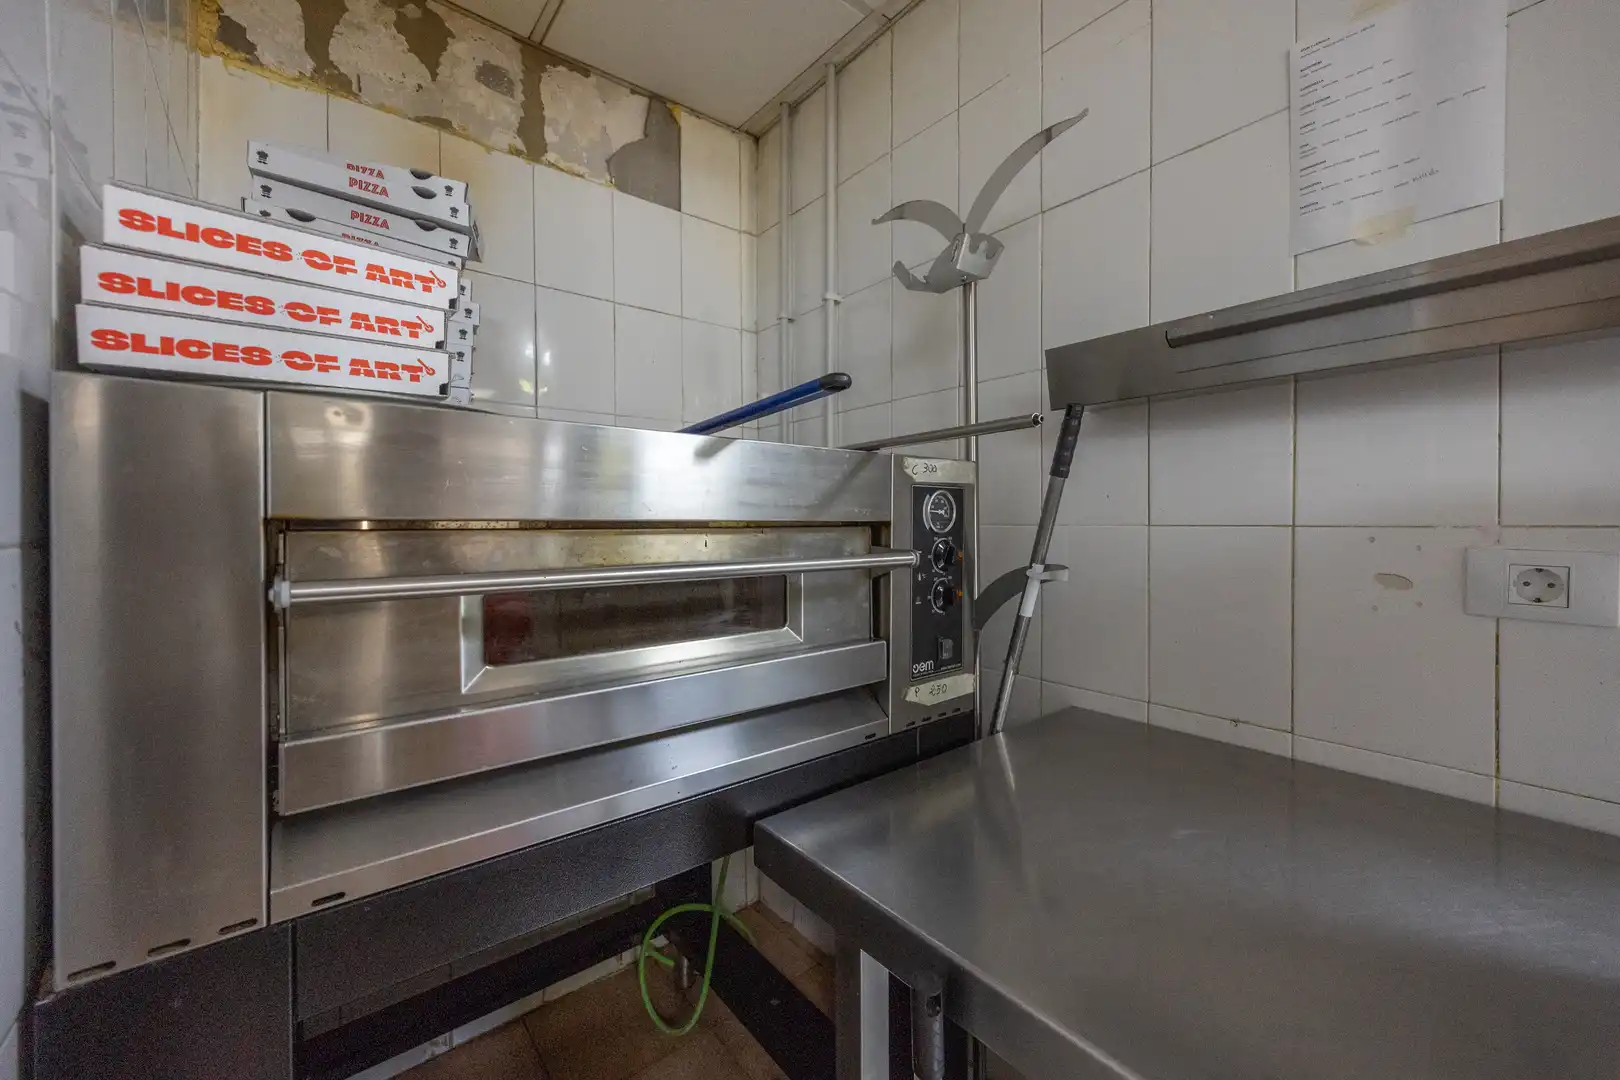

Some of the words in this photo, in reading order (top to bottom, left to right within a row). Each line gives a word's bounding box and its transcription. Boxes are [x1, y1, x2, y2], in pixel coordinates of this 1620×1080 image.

[349, 177, 389, 197] PIZZA
[350, 210, 390, 230] PIZZA
[119, 209, 293, 262] SLICES
[301, 249, 357, 275] OF
[365, 263, 436, 293] ART
[98, 271, 275, 316] SLICES
[283, 301, 342, 326] OF
[350, 312, 425, 339] ART
[91, 329, 273, 366] SLICES
[281, 350, 341, 373] OF
[349, 358, 424, 383] ART
[911, 464, 918, 476] C
[922, 462, 938, 474] 300
[912, 659, 934, 674] oem
[929, 683, 947, 697] 250
